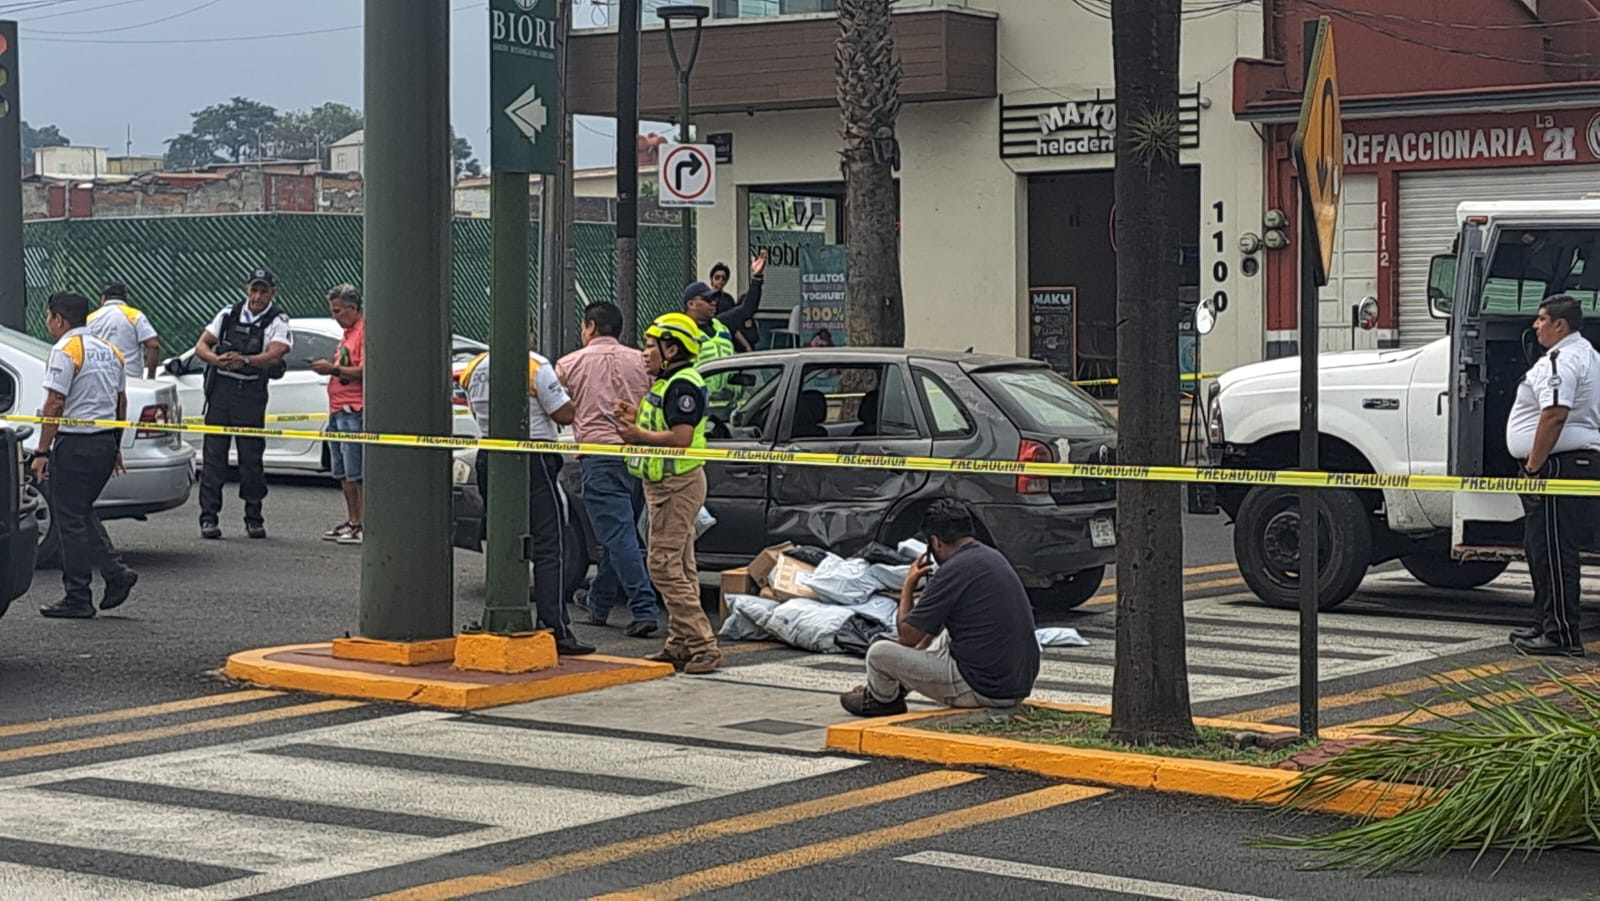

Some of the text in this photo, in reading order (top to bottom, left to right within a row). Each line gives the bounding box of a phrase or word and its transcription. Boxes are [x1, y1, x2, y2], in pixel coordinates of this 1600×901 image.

[492, 9, 556, 50] BIORI
[1038, 102, 1117, 135] MAKU
[1036, 134, 1115, 156] heladeri
[1342, 113, 1576, 165] REFACCIONARIA La 21
[1212, 201, 1228, 312] 1100
[1033, 293, 1072, 305] MAKU
[803, 307, 844, 321] 100%
[1326, 473, 1410, 487] PRECAUCION
[1460, 476, 1547, 492] PRECAUCION
